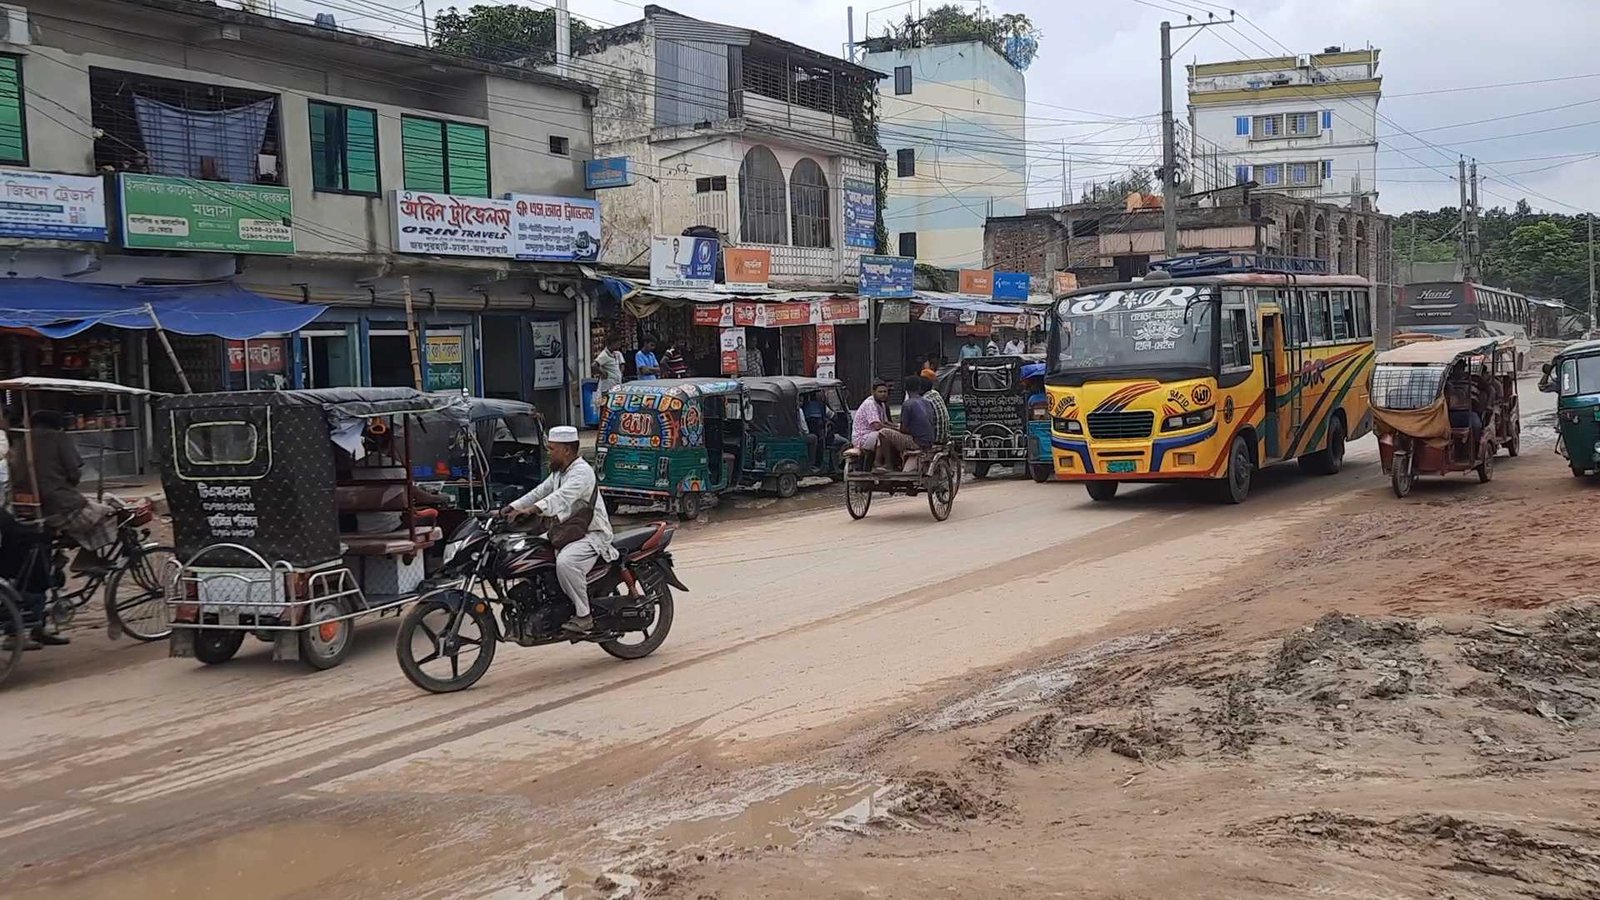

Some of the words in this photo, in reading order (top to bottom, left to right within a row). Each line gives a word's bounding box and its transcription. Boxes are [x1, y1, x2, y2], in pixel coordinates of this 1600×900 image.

[5, 180, 48, 200] জিহান
[192, 203, 233, 217] মাদ্রাসা
[400, 195, 446, 222] অরিন
[402, 226, 459, 236] ORIN
[461, 230, 507, 240] TRAVELS
[1169, 389, 1190, 407] RAFID
